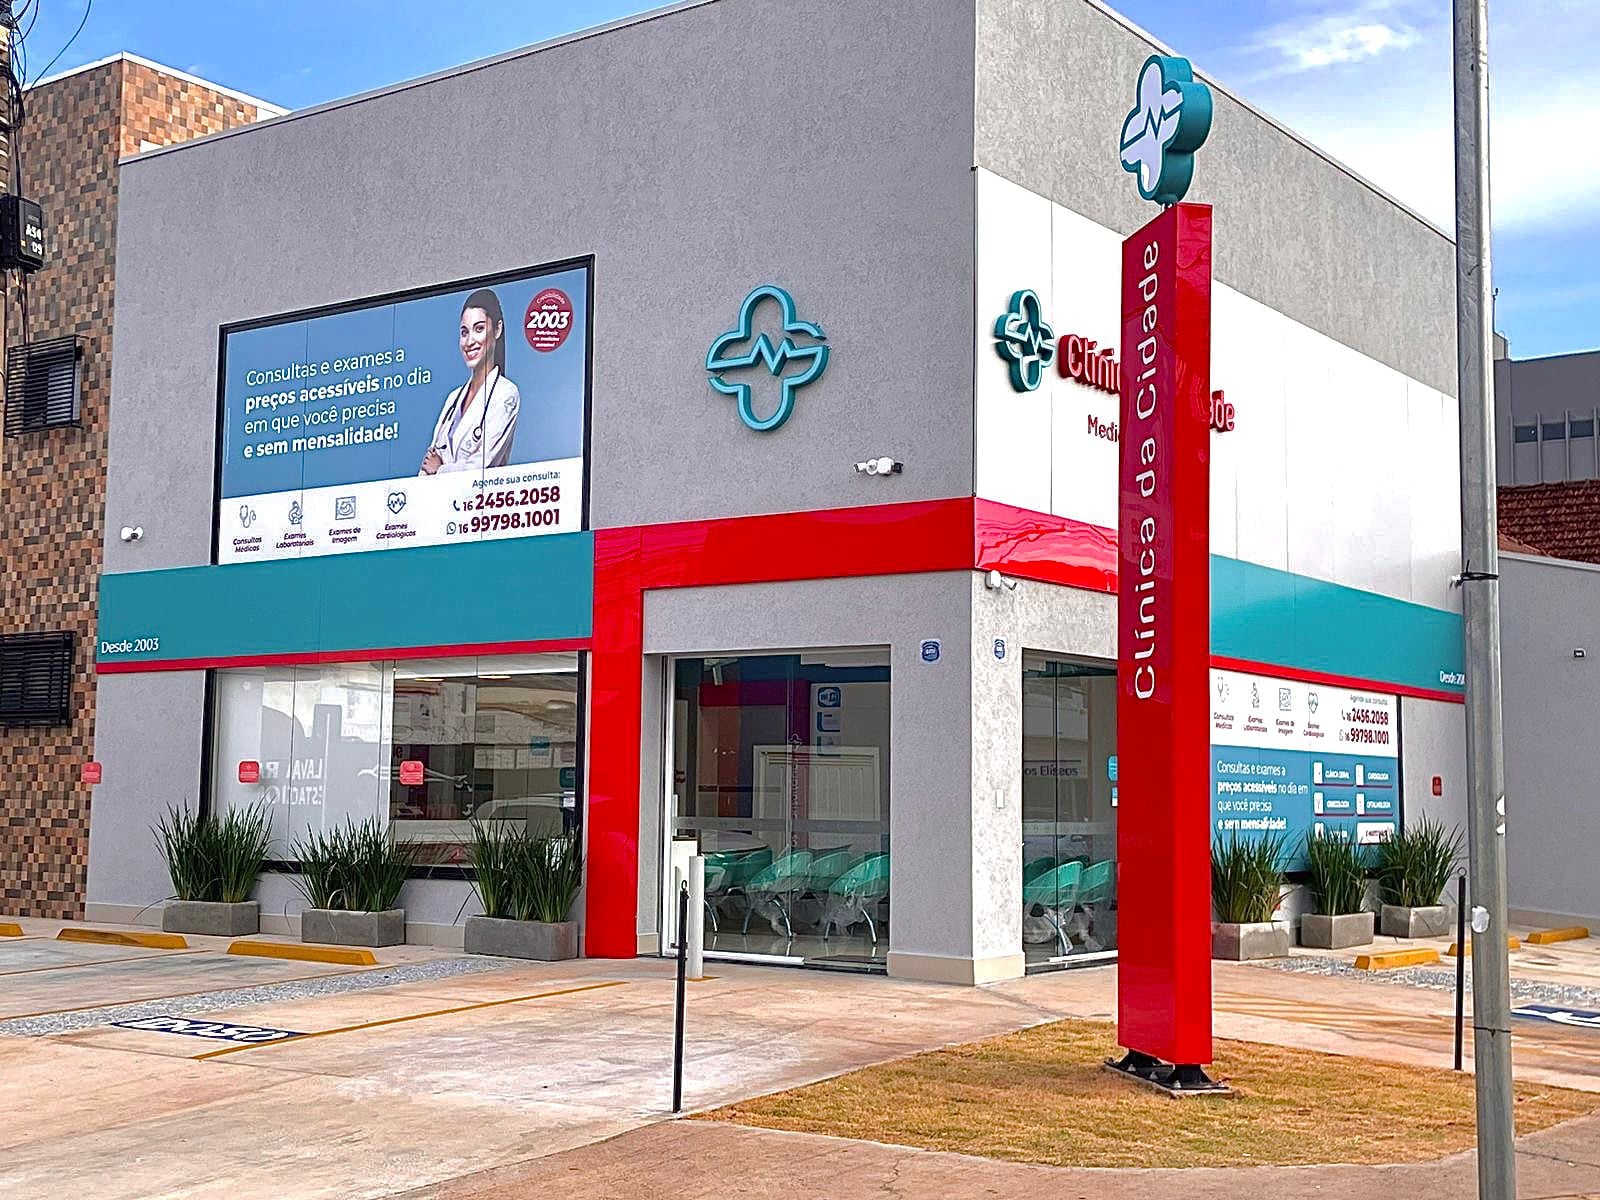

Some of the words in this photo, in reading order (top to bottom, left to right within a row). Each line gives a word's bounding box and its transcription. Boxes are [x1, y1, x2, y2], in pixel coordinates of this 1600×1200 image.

[526, 311, 570, 329] 2003
[1136, 240, 1158, 420] Cidade
[246, 362, 317, 386] Consultas
[320, 362, 330, 375] e
[333, 350, 392, 372] exames
[396, 349, 405, 362] a
[245, 390, 296, 414] preços
[300, 373, 380, 402] acessíveis
[383, 374, 403, 390] no
[407, 367, 432, 386] dia
[244, 418, 268, 434] em
[271, 414, 300, 434] que
[302, 405, 338, 426] você
[341, 398, 396, 424] precisa
[1088, 414, 1120, 442] Medi
[244, 445, 253, 458] e
[256, 440, 288, 457] sem
[292, 422, 400, 452] mensalidade!
[1135, 437, 1156, 498] da
[472, 478, 504, 489] Agende
[506, 475, 521, 485] sua
[522, 471, 560, 483] consulta:
[463, 500, 474, 512] 16
[475, 486, 560, 510] 2456.2058
[384, 523, 408, 532] Exames
[458, 524, 468, 534] 16
[471, 508, 560, 533] 99798.1001
[284, 532, 306, 540] Exames
[329, 527, 351, 537] Exames
[352, 526, 362, 534] de
[232, 536, 262, 546] Consultas
[1134, 516, 1156, 699] Clínica
[101, 641, 132, 654] Desde
[134, 638, 159, 652] 2003
[1352, 708, 1388, 726] 2456.2058
[1350, 728, 1389, 744] 99798.1001
[1217, 760, 1250, 774] Consultas
[1250, 765, 1256, 774] e
[1256, 765, 1281, 776] exames
[1281, 766, 1286, 776] a
[1218, 781, 1242, 795] preços
[1242, 780, 1278, 794] acessíveis
[1278, 784, 1286, 794] no
[1287, 782, 1297, 794] dia
[1298, 784, 1308, 794] em
[1218, 800, 1232, 814] que
[1232, 798, 1248, 811] você
[1249, 799, 1272, 814] precisa
[1218, 820, 1224, 830] e
[1224, 819, 1240, 830] sem
